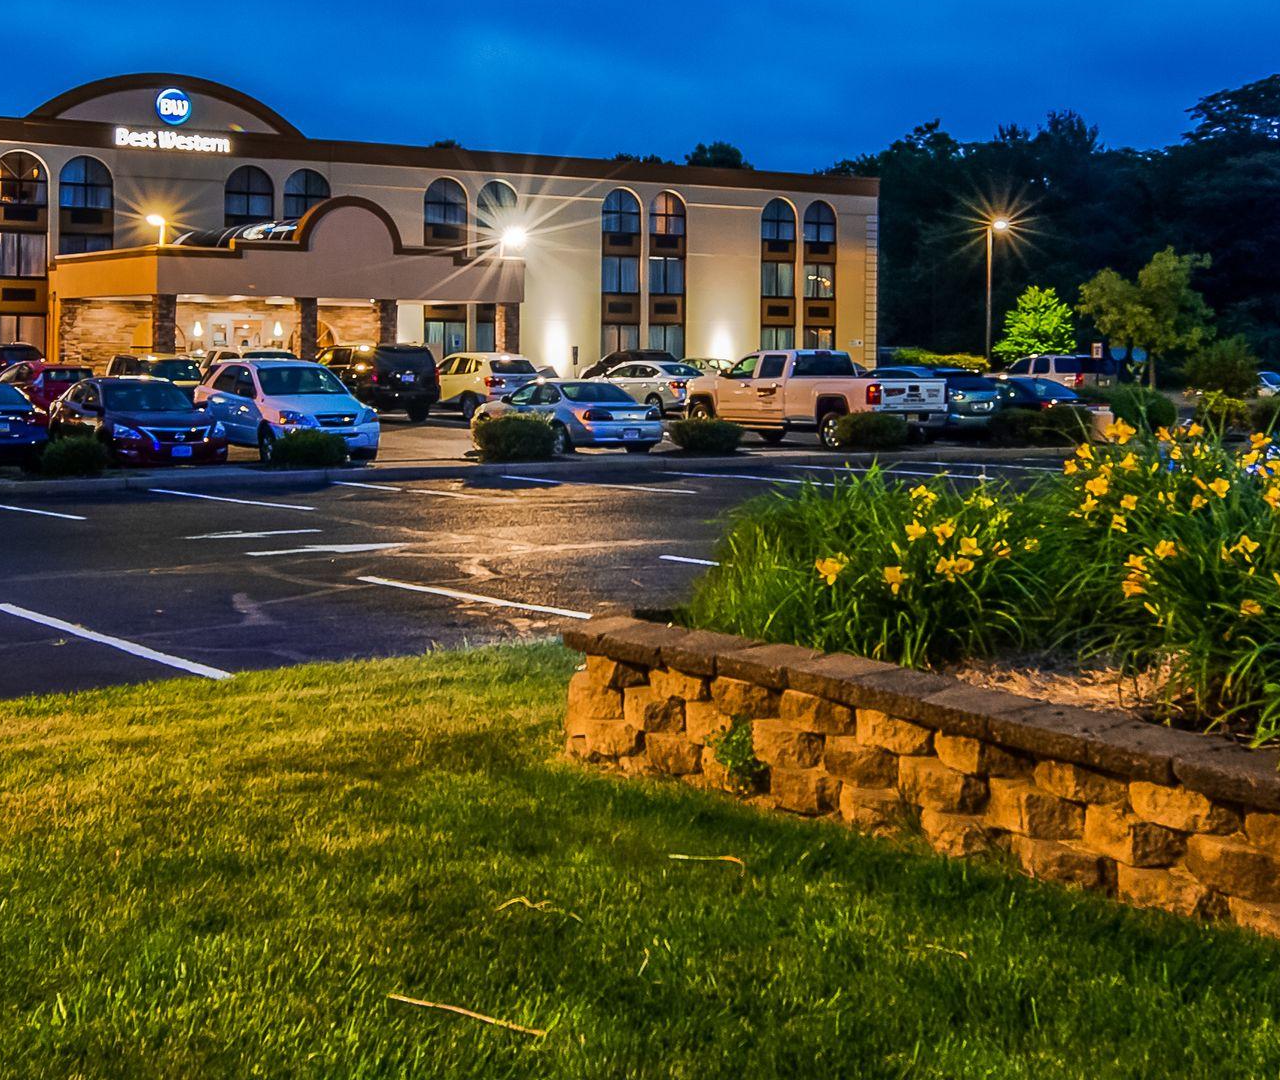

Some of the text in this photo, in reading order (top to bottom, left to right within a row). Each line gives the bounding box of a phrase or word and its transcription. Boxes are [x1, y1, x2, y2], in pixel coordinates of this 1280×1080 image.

[160, 98, 188, 116] BW
[115, 127, 231, 153] Best Western
